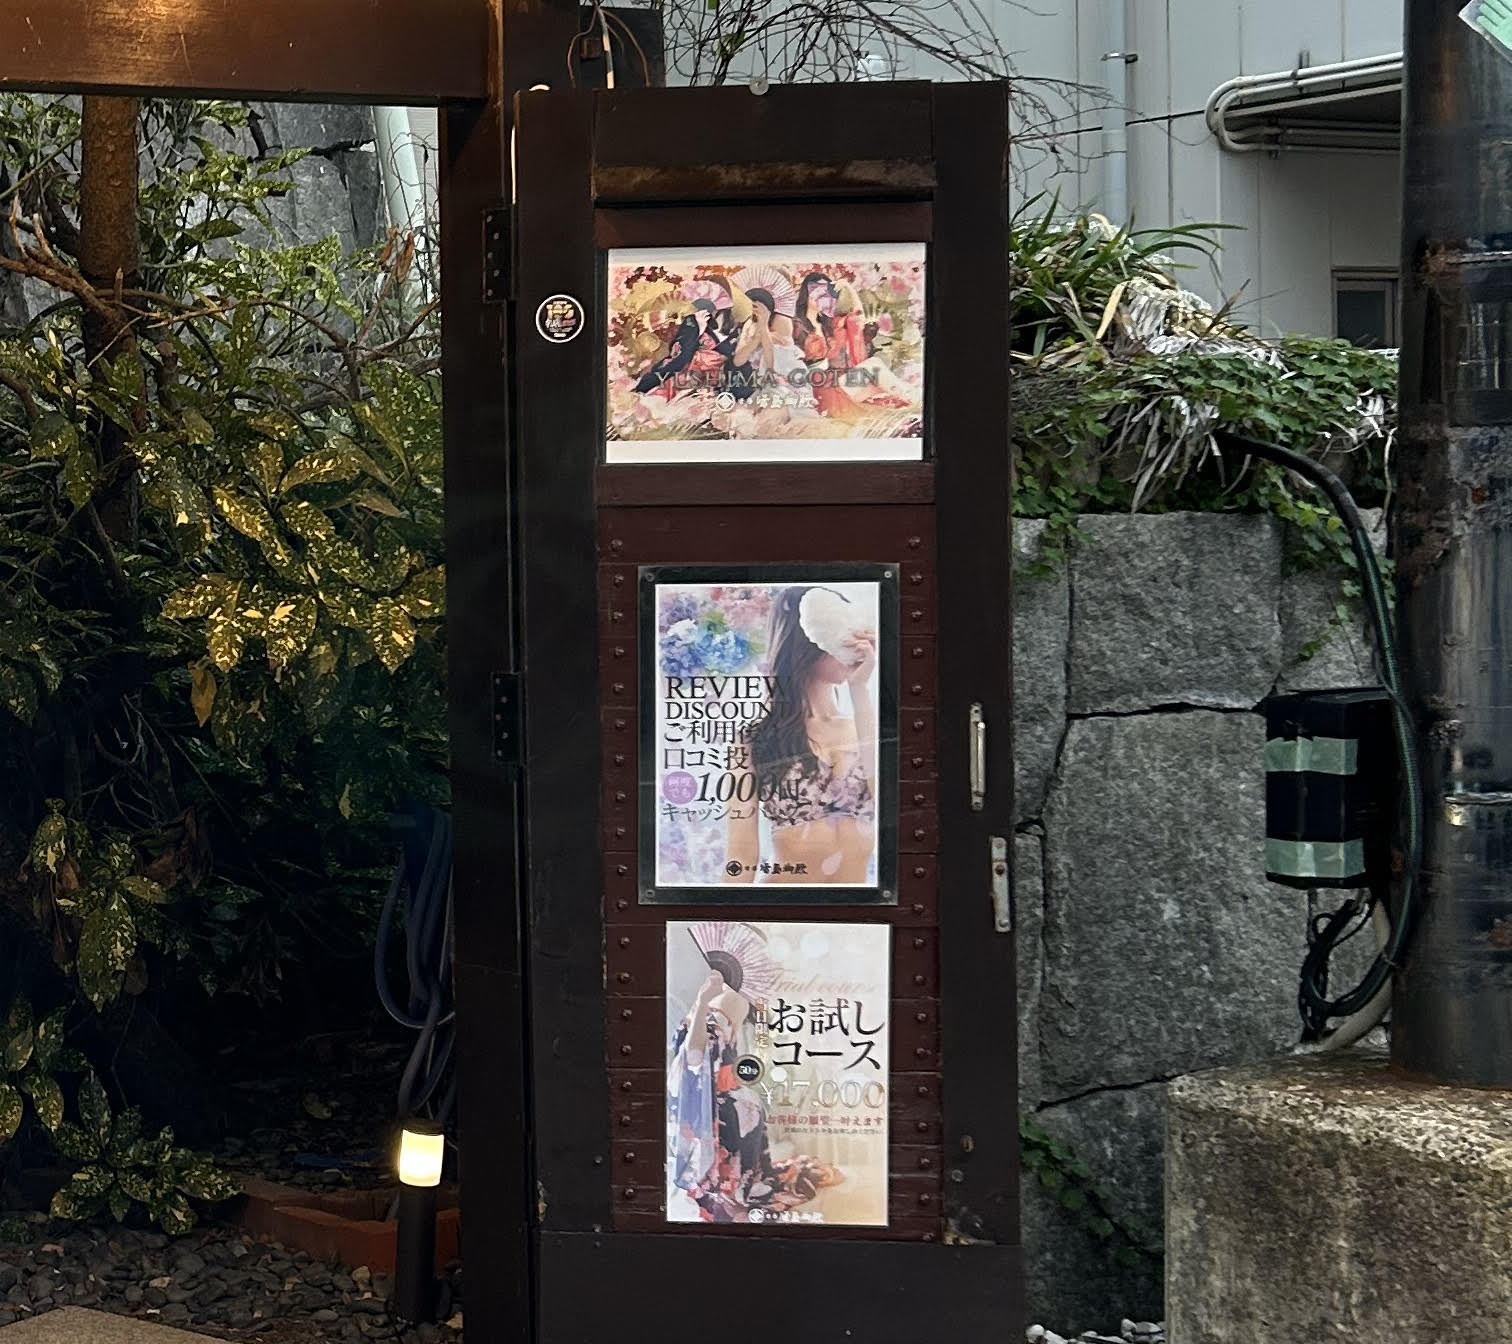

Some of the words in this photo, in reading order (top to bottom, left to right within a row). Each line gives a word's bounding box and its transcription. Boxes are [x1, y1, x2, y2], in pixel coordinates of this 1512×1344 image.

[768, 997, 885, 1036] お試し
[772, 1040, 881, 1070] コース
